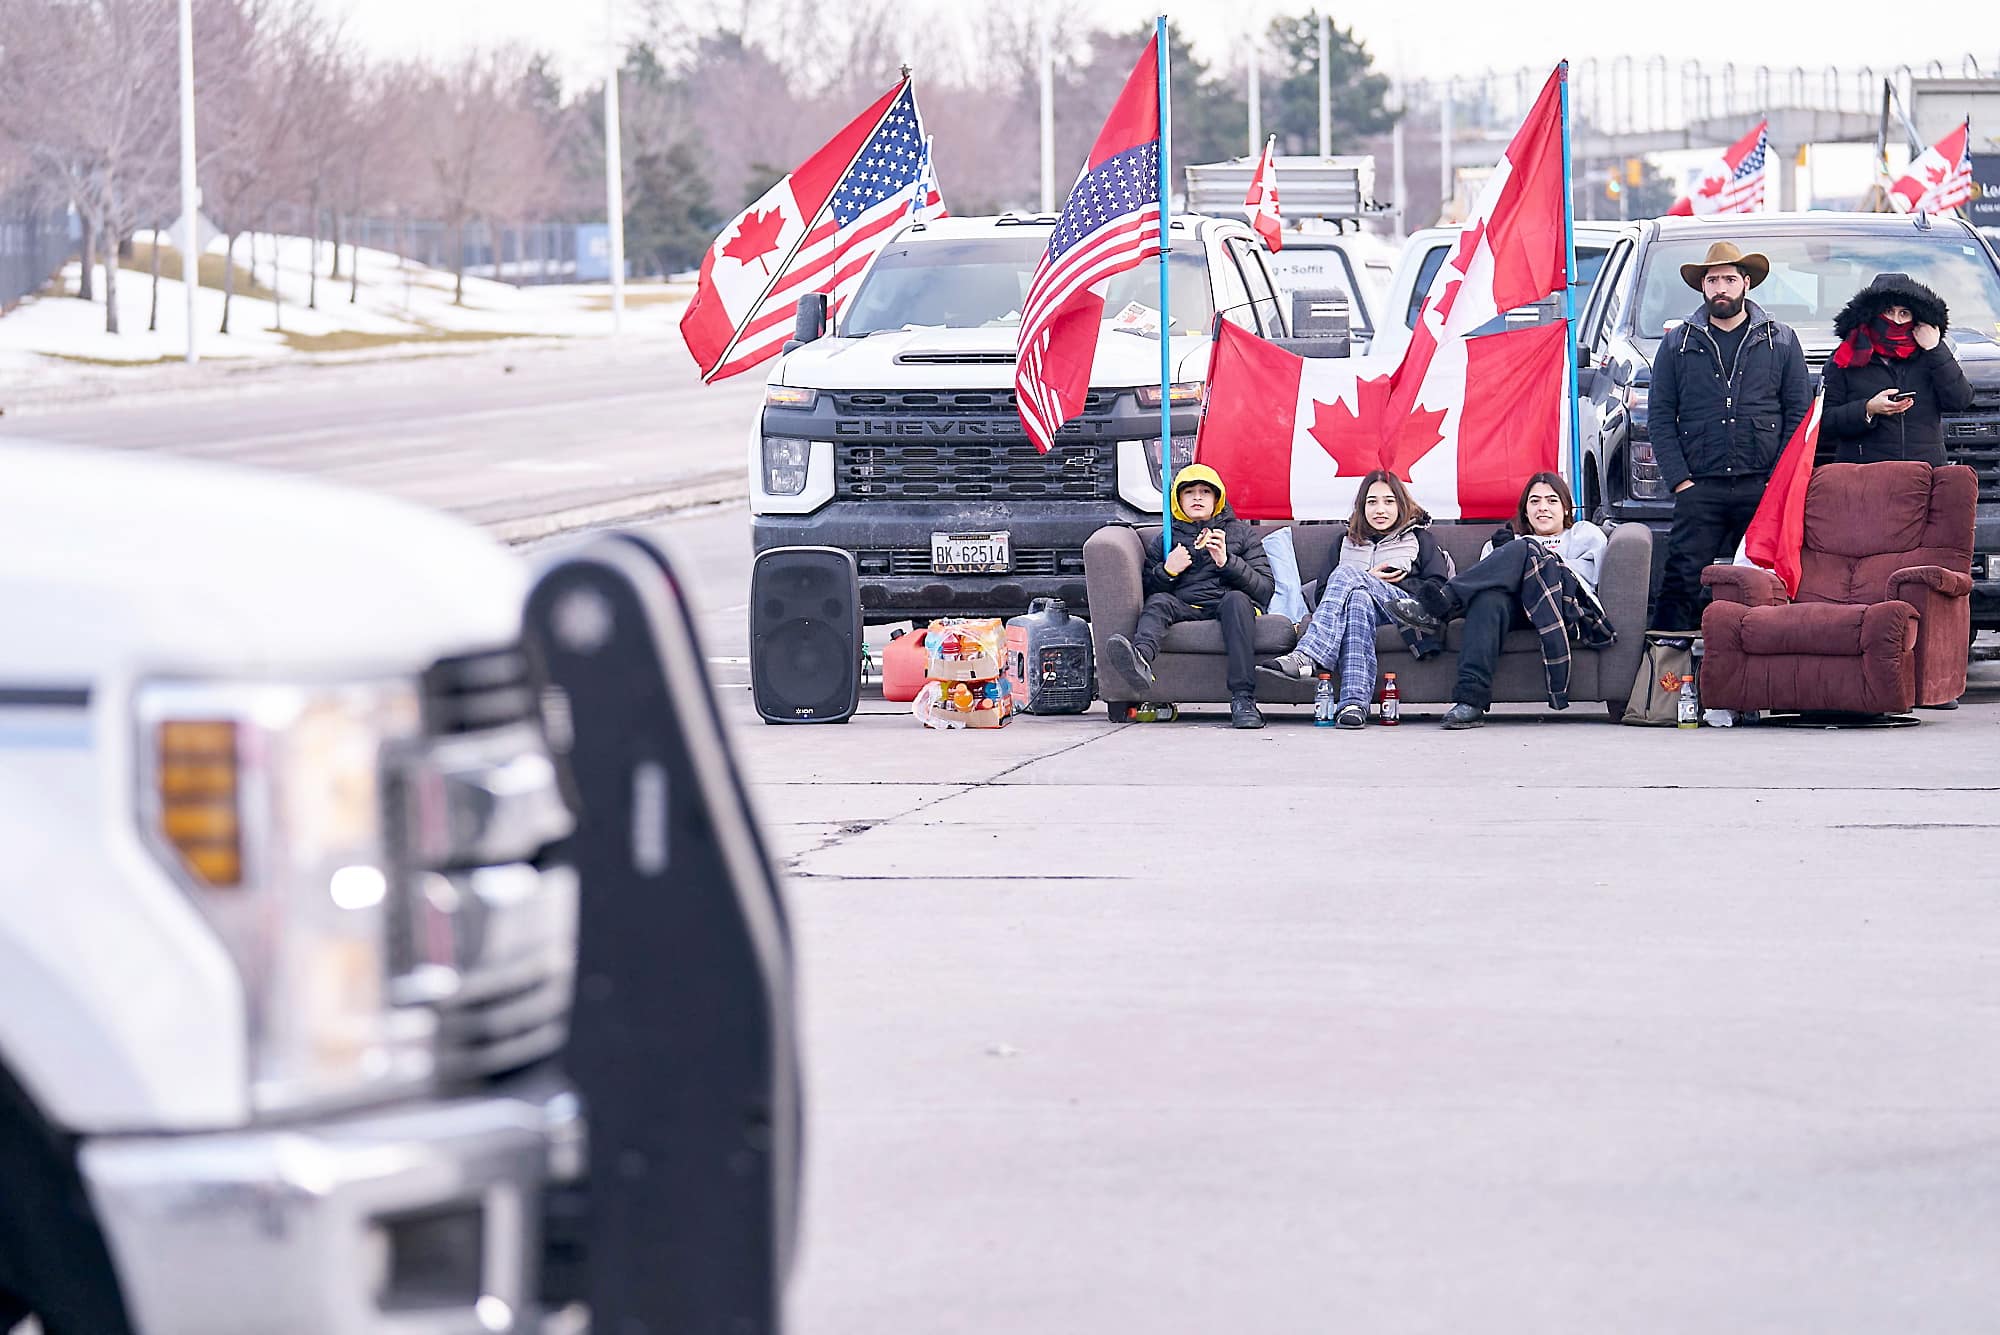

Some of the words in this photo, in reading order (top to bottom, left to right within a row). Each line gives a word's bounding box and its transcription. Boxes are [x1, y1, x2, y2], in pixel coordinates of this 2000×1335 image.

[1291, 264, 1324, 275] Soffit
[835, 419, 1113, 436] CHEVROET
[935, 564, 987, 573] LALLY
